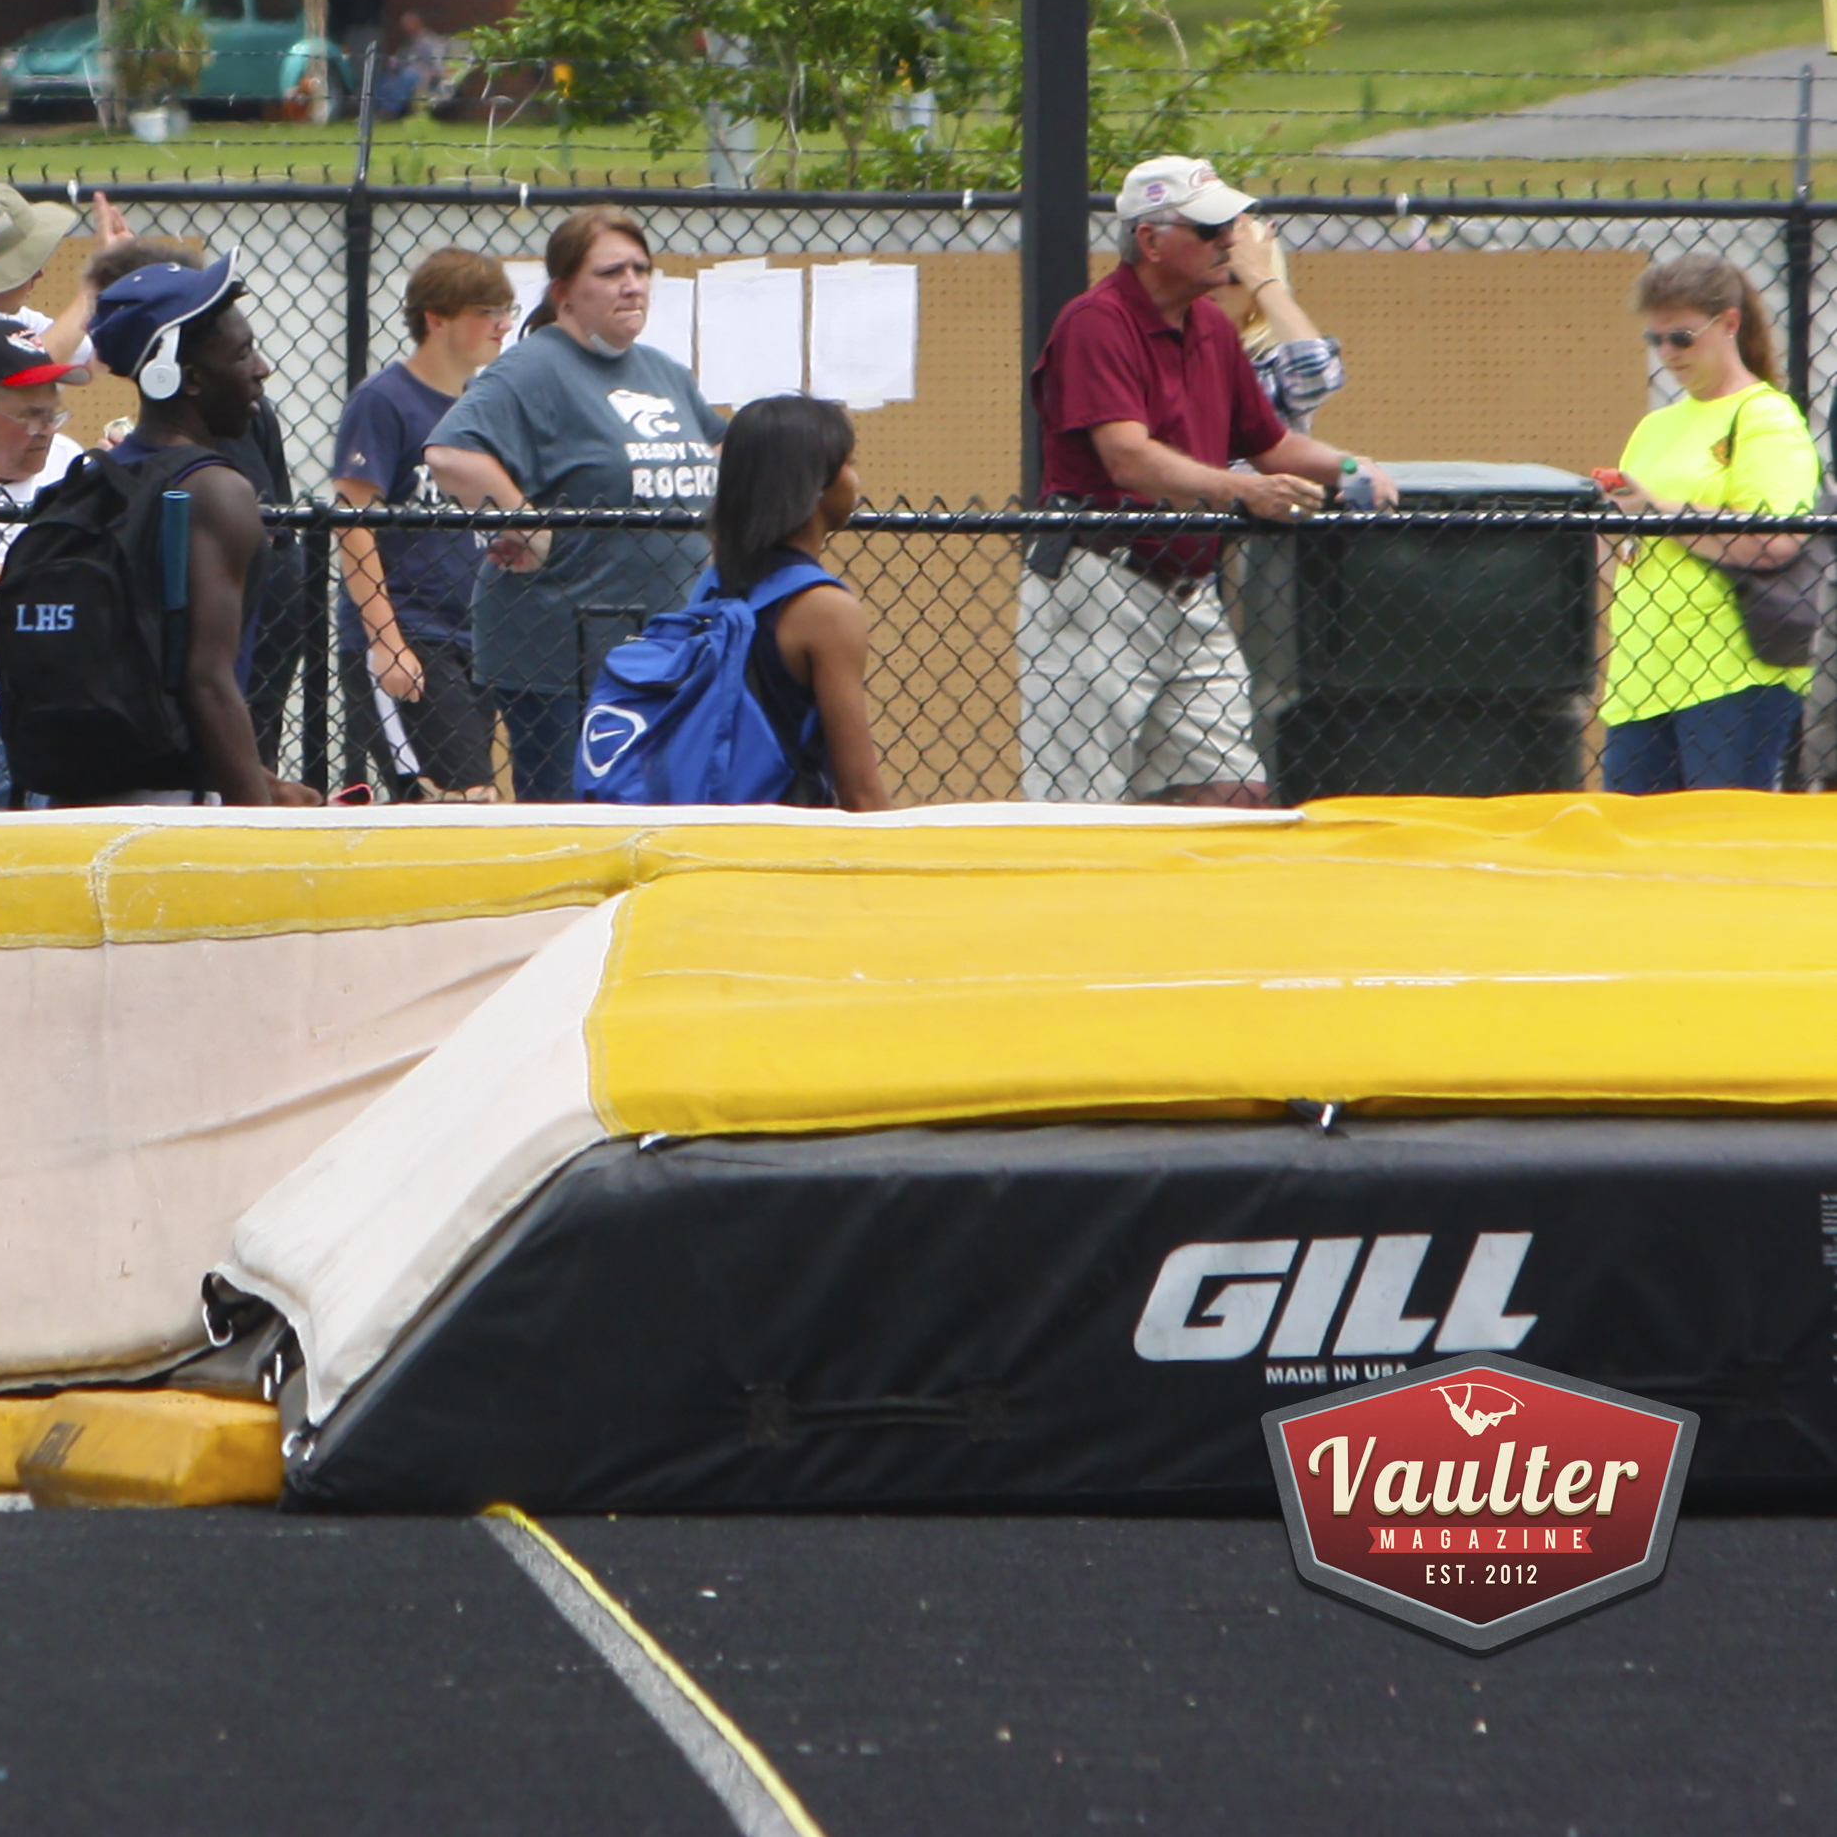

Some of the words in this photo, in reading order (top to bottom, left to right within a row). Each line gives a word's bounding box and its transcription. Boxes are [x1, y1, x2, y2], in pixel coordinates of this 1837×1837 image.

[15, 604, 75, 632] LHS
[1133, 1232, 1538, 1361] GILL
[1266, 1365, 1327, 1384] MADE
[1333, 1364, 1357, 1382] IN
